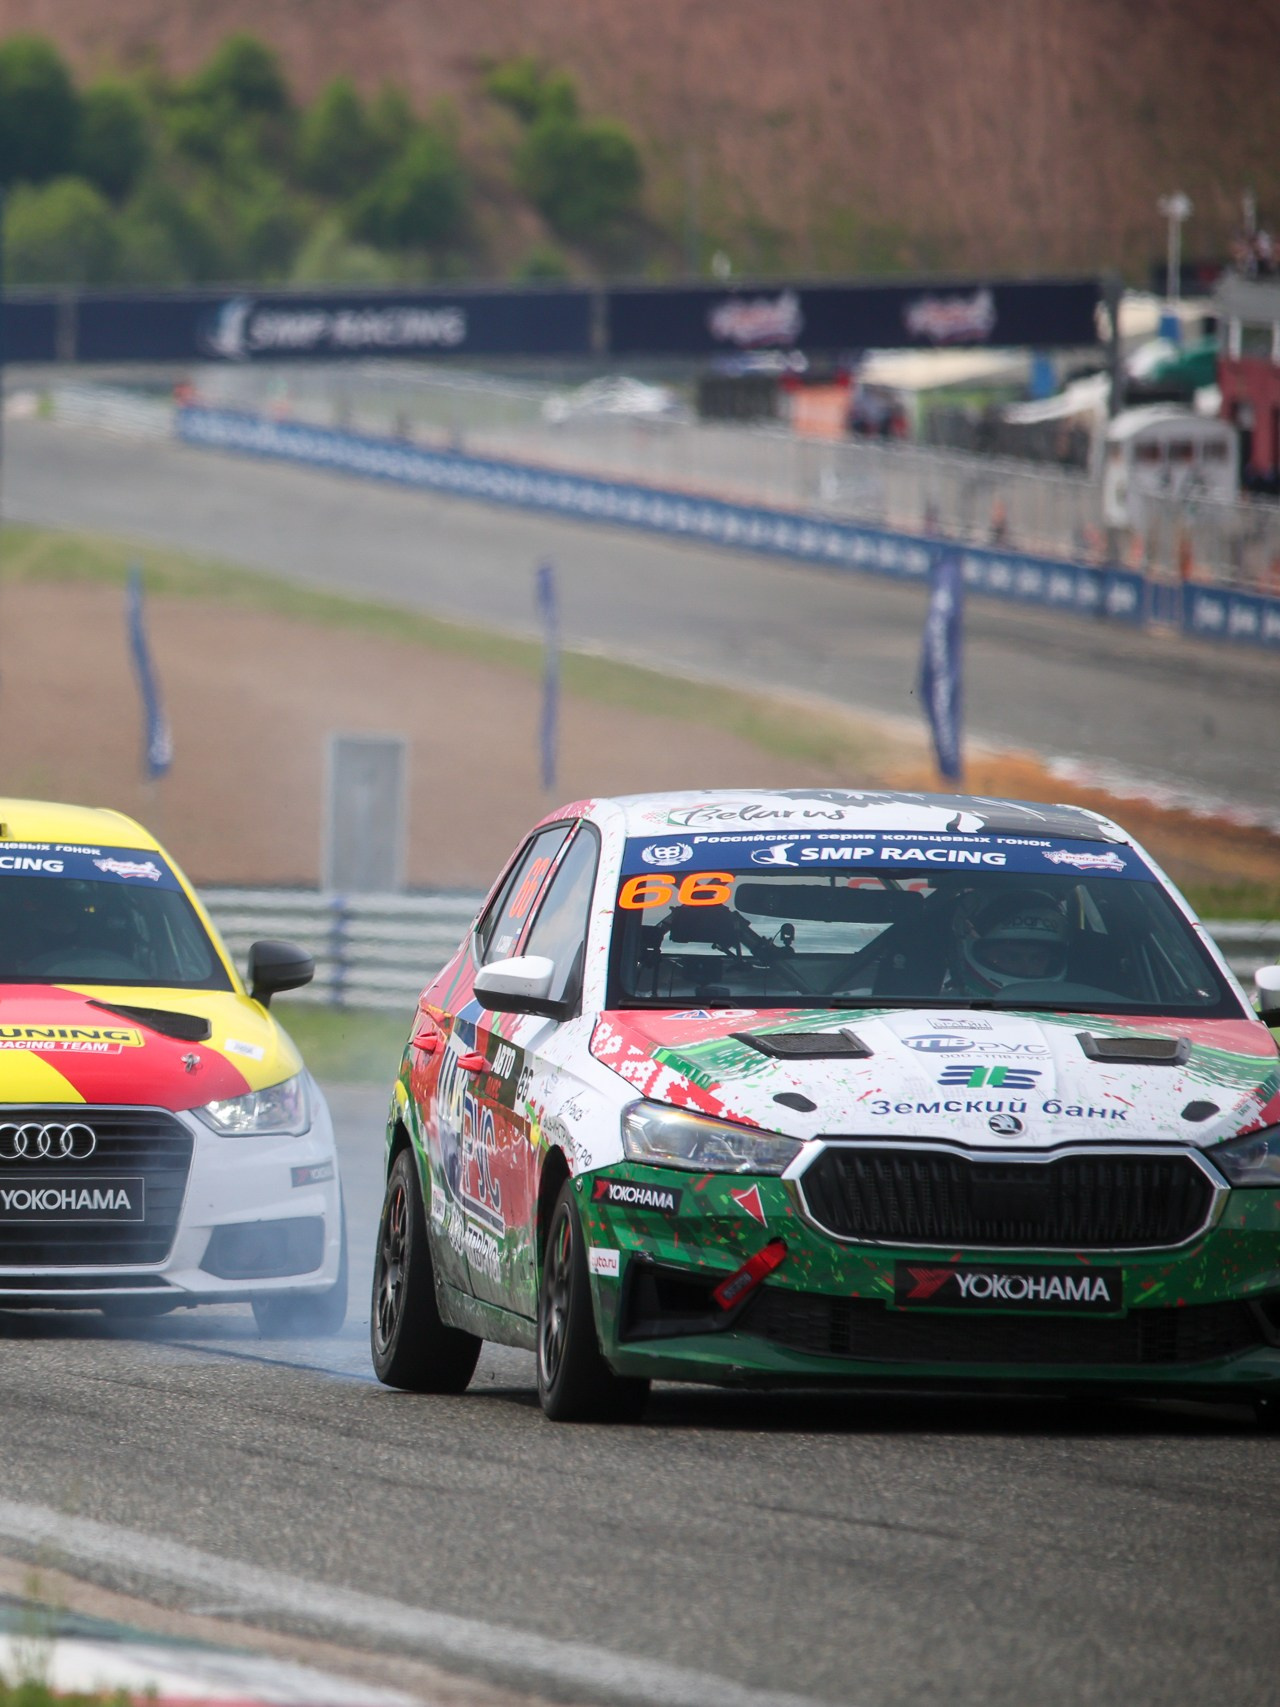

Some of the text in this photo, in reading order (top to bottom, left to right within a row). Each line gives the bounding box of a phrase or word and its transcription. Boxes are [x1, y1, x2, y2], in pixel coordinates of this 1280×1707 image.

[680, 804, 848, 827] Belarus
[55, 844, 102, 855] гонок
[693, 833, 1052, 847] Российская серия кольцевых гонок
[800, 847, 1007, 865] SMP RACING
[618, 872, 736, 909] 66
[62, 1042, 110, 1052] TEAM
[491, 1043, 516, 1080] АВТО
[870, 1097, 1128, 1121] Земский банк
[0, 1189, 131, 1210] YOKOHAMA
[608, 1184, 674, 1210] YOKOHAMA
[956, 1273, 1110, 1302] YOKOHAMA
